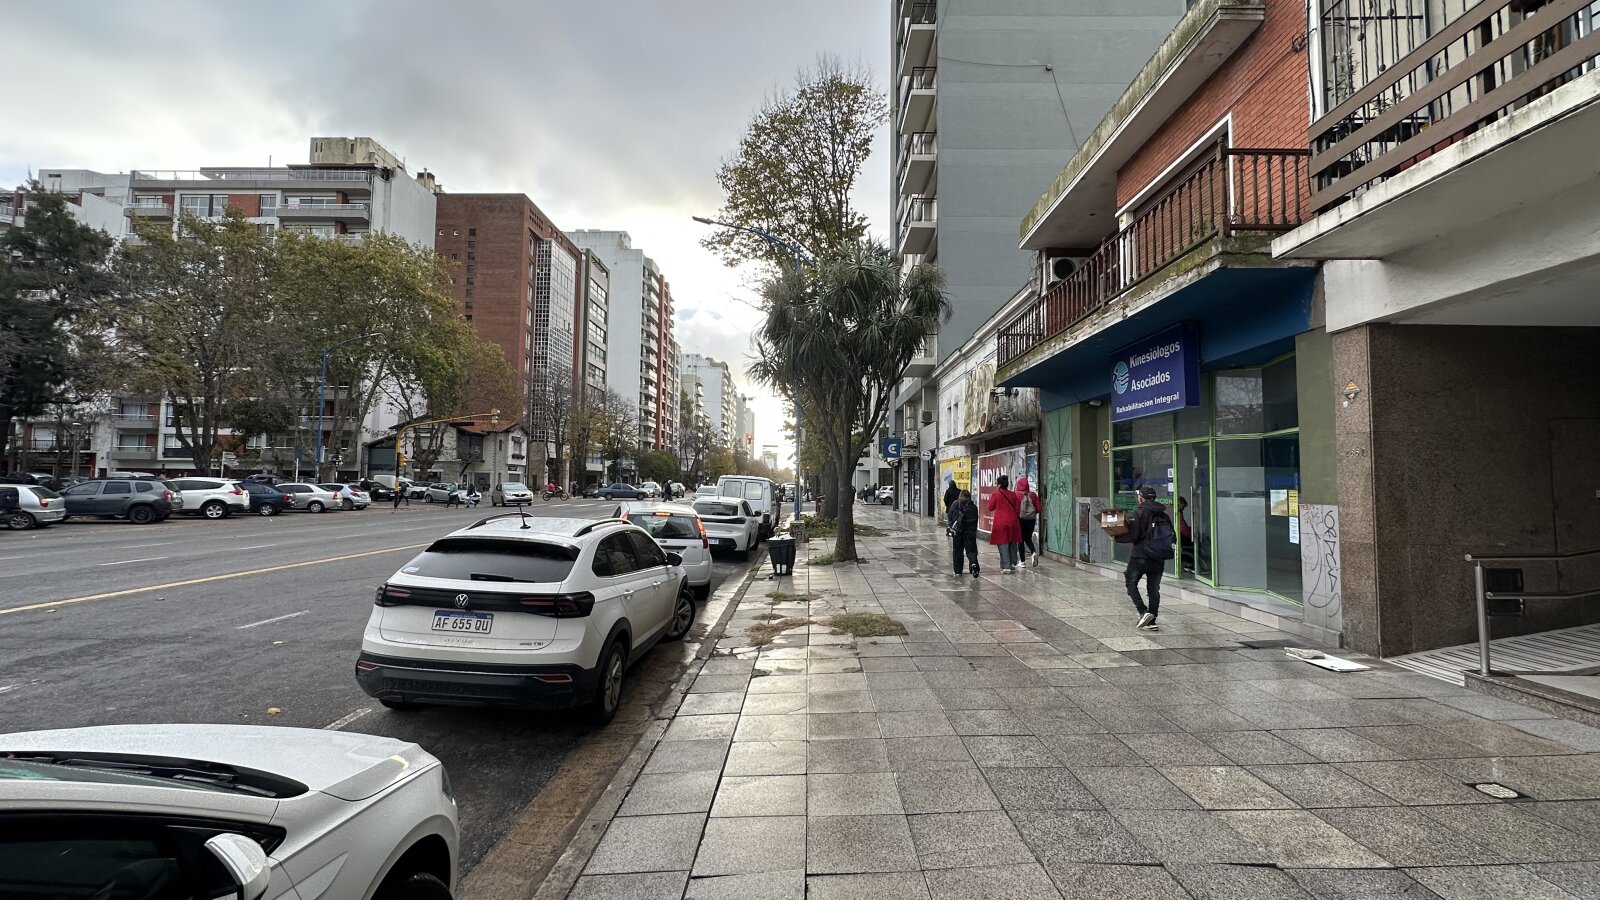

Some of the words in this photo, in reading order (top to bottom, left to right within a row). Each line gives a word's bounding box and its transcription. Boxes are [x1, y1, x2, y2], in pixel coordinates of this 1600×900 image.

[1131, 370, 1170, 392] Asociados
[1154, 392, 1179, 404] Integral
[435, 617, 449, 629] AF
[451, 618, 472, 630] 655
[474, 619, 489, 631] QU
